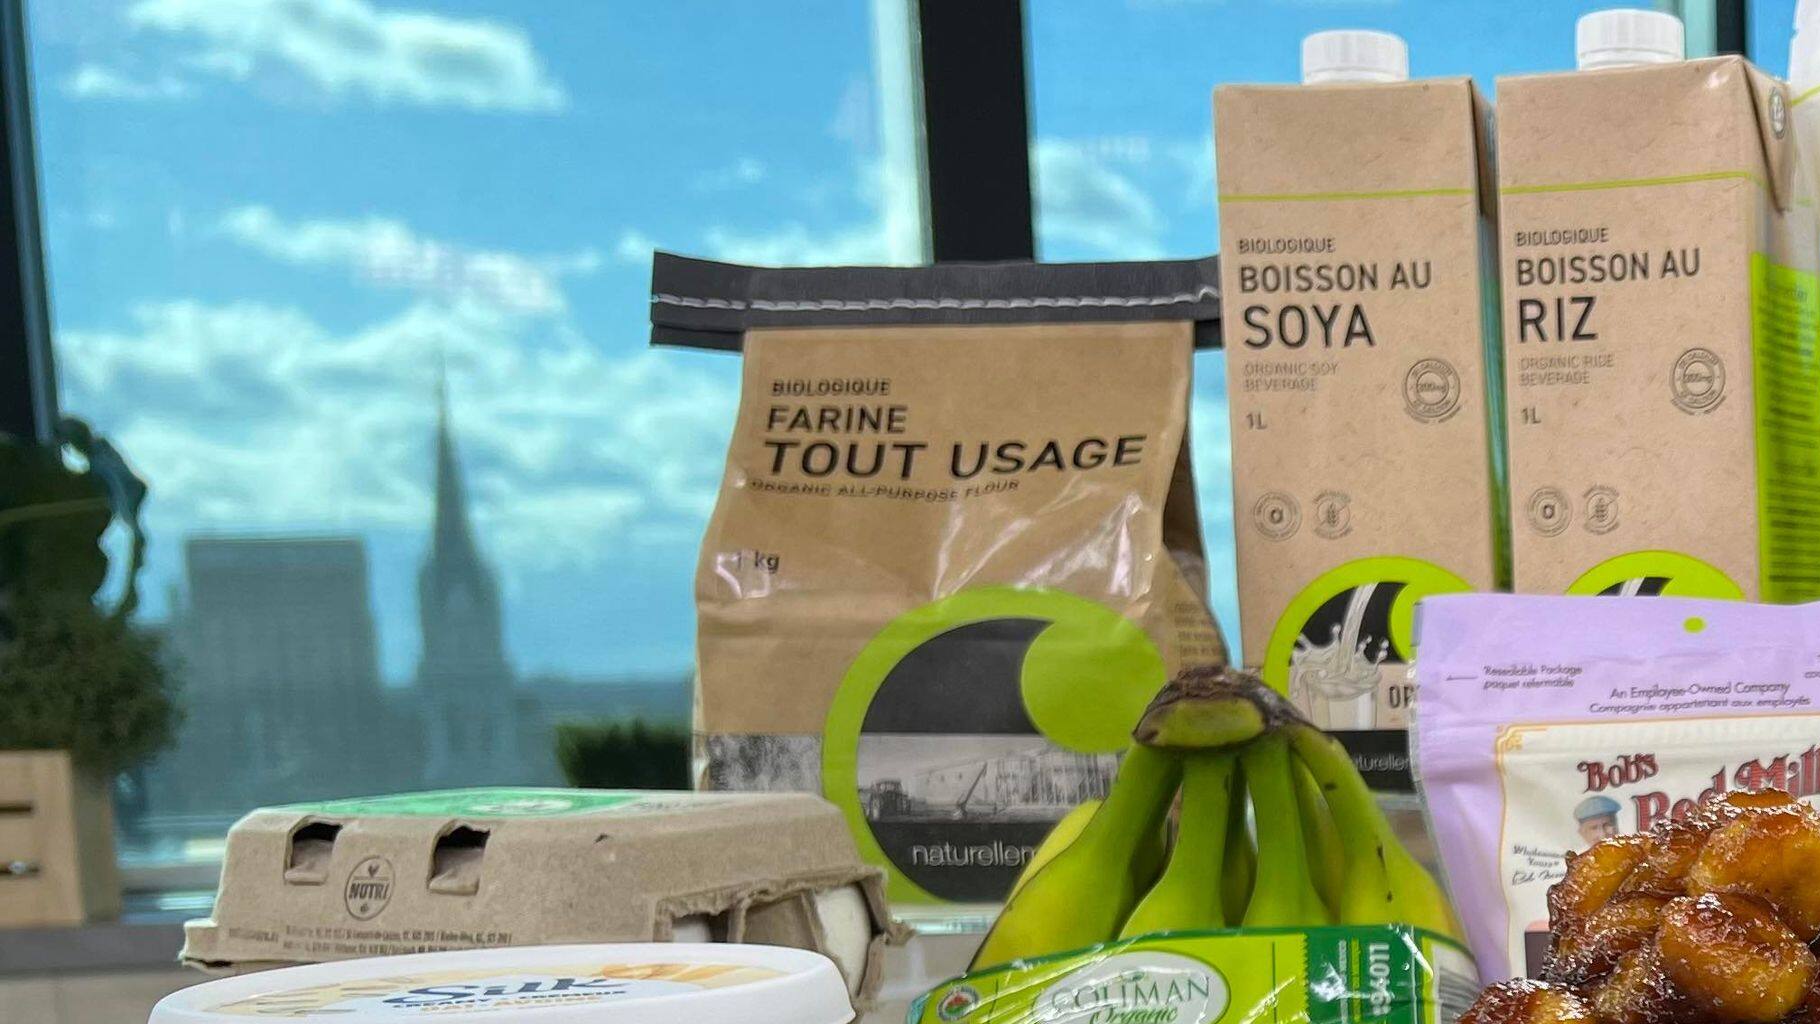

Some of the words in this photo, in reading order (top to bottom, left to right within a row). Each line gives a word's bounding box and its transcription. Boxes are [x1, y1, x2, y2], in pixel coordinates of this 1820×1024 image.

[1239, 238, 1337, 254] BIOLOGIQUE
[1516, 227, 1610, 247] BIOLOGIQUE
[1240, 262, 1378, 293] BOISSON
[1389, 261, 1432, 290] AU
[1517, 252, 1650, 287] BOISSON
[1660, 247, 1701, 279] AU
[1243, 303, 1377, 349] SOYA
[1518, 295, 1599, 343] RIZ
[1244, 362, 1307, 377] ORGANIC
[1520, 355, 1581, 370] ORGANIC
[771, 378, 891, 397] BIOLOGIQUE
[766, 405, 908, 434] FARINE
[764, 440, 928, 478] TOUT
[951, 433, 1148, 479] USAGE
[964, 478, 1020, 499] FLOUR
[755, 549, 780, 575] kg
[1541, 663, 1583, 677] Package
[1610, 687, 1628, 700] An
[1630, 682, 1731, 700] Employee-Owned
[1734, 681, 1791, 700] Company
[1588, 701, 1656, 715] Compagnie
[1659, 698, 1729, 713] appartenant
[1577, 752, 1659, 793] Bob's
[382, 978, 633, 1004] Silk
